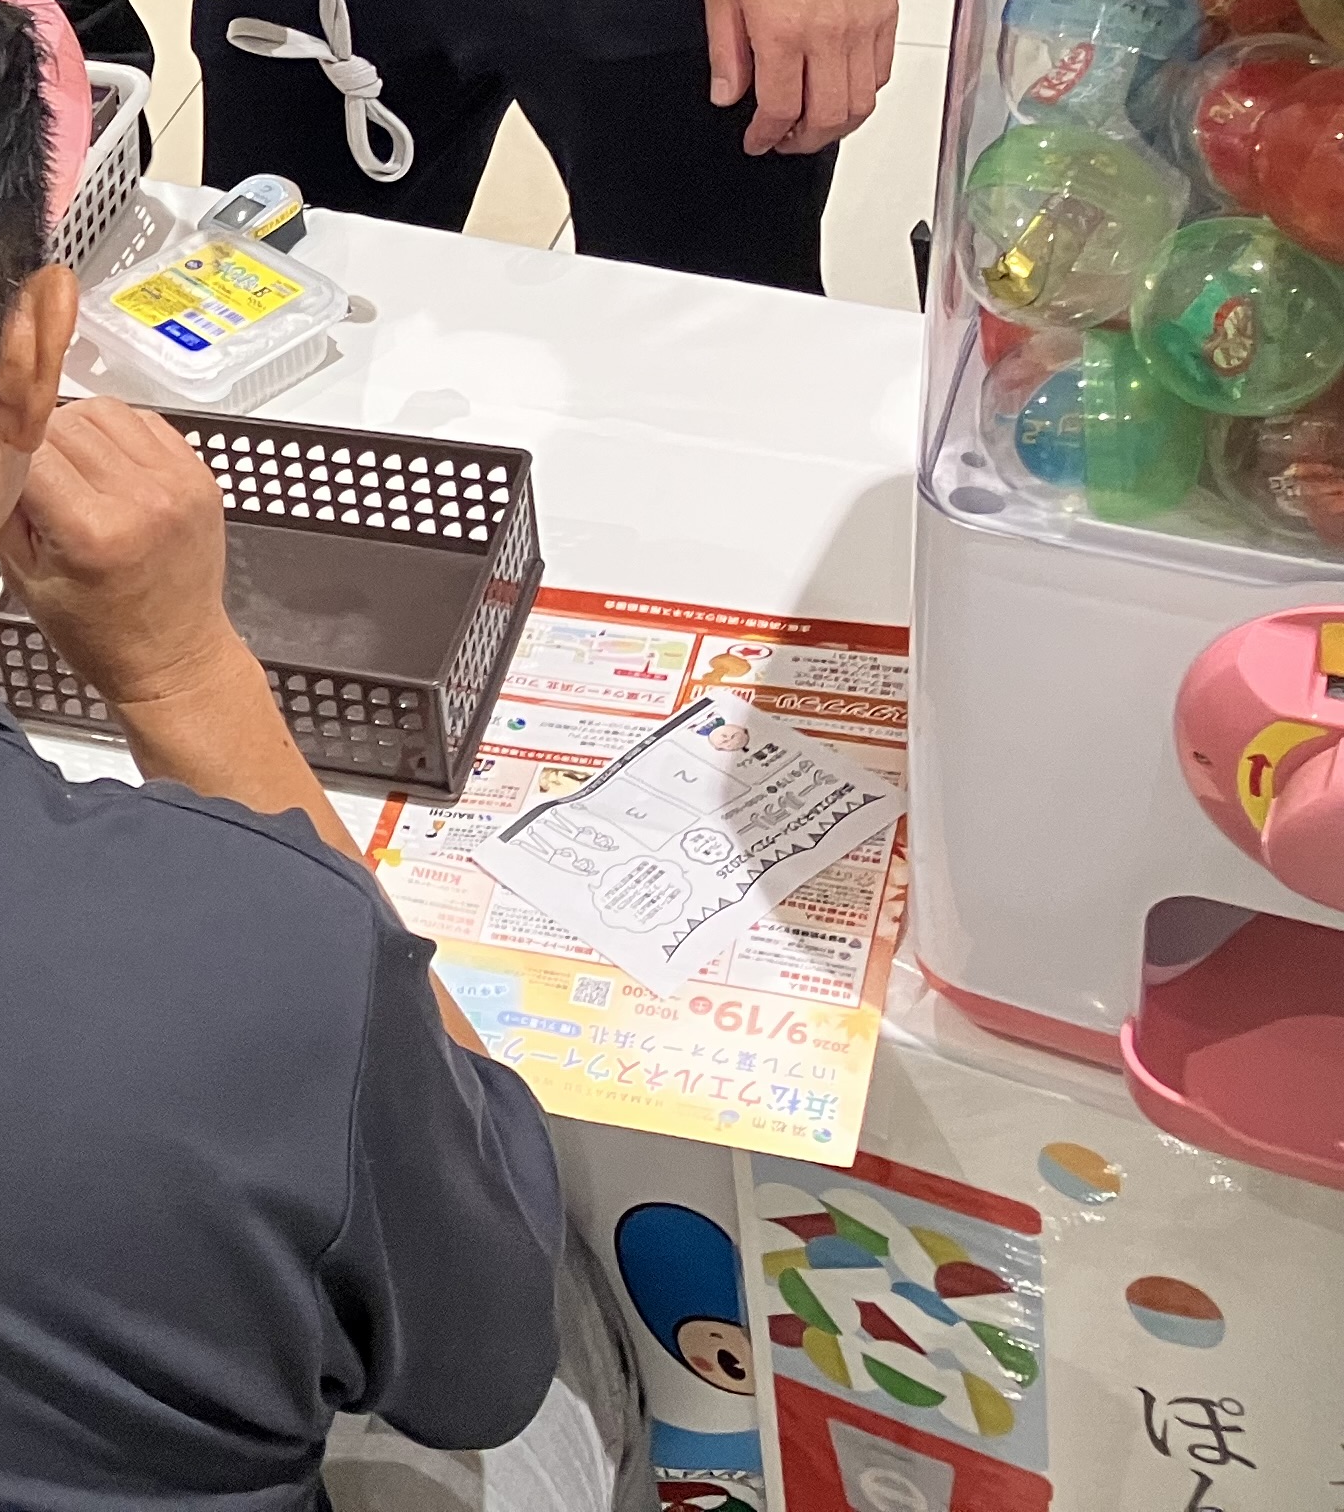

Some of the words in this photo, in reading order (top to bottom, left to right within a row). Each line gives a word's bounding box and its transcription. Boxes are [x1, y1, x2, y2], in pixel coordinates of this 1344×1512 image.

[672, 764, 698, 791] 2
[428, 807, 474, 820] SAICHI
[622, 801, 646, 825] 3
[410, 865, 462, 885] KIRIN
[634, 1003, 680, 1022] 10:00
[713, 1000, 808, 1045] 9/19
